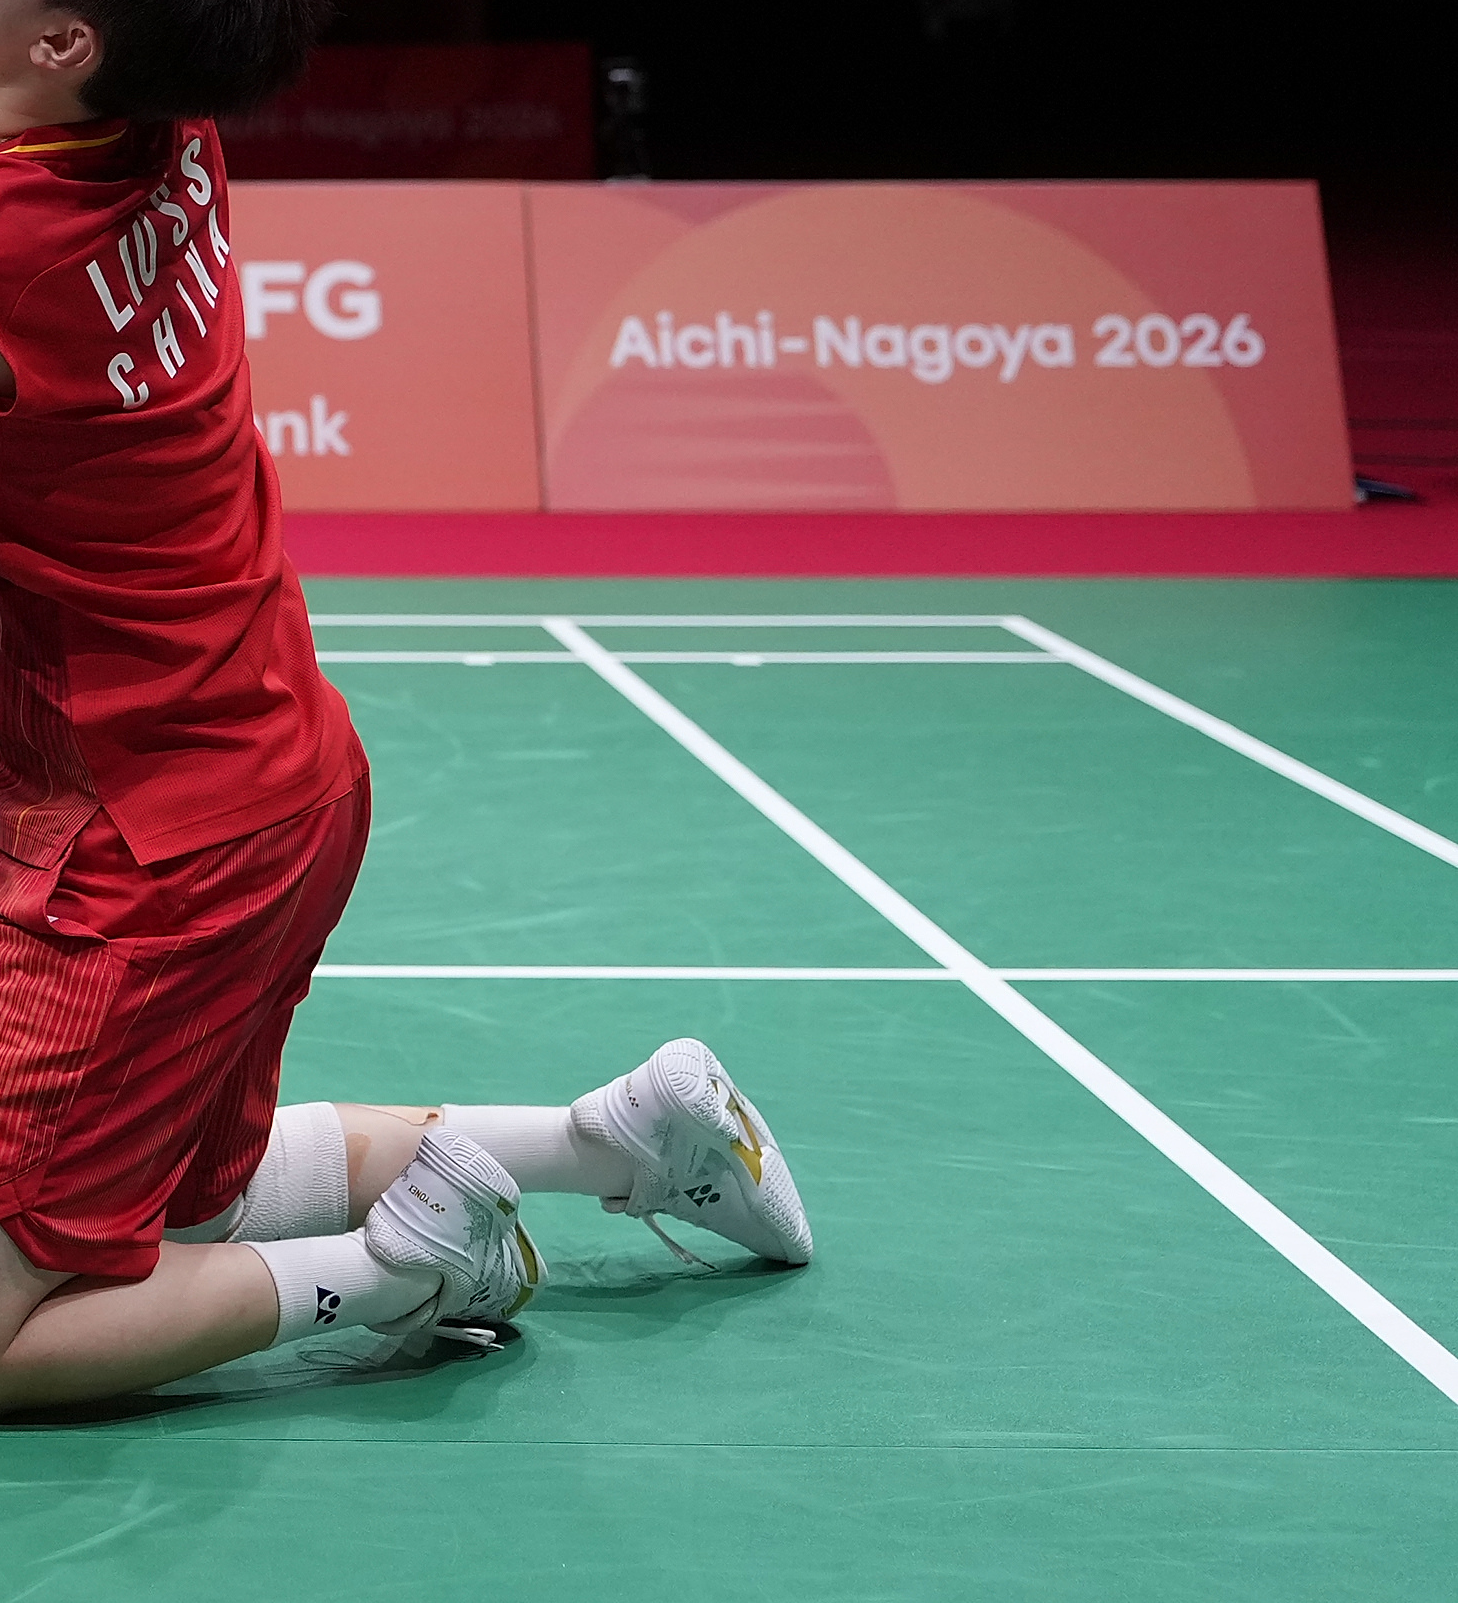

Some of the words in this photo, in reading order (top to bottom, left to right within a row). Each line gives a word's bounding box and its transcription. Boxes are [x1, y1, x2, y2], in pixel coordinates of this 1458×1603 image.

[107, 204, 230, 410] CHINA
[242, 260, 381, 340] FG
[609, 310, 1077, 384] Aichi-Nagoya
[1092, 312, 1268, 370] 2026
[254, 394, 353, 457] nk
